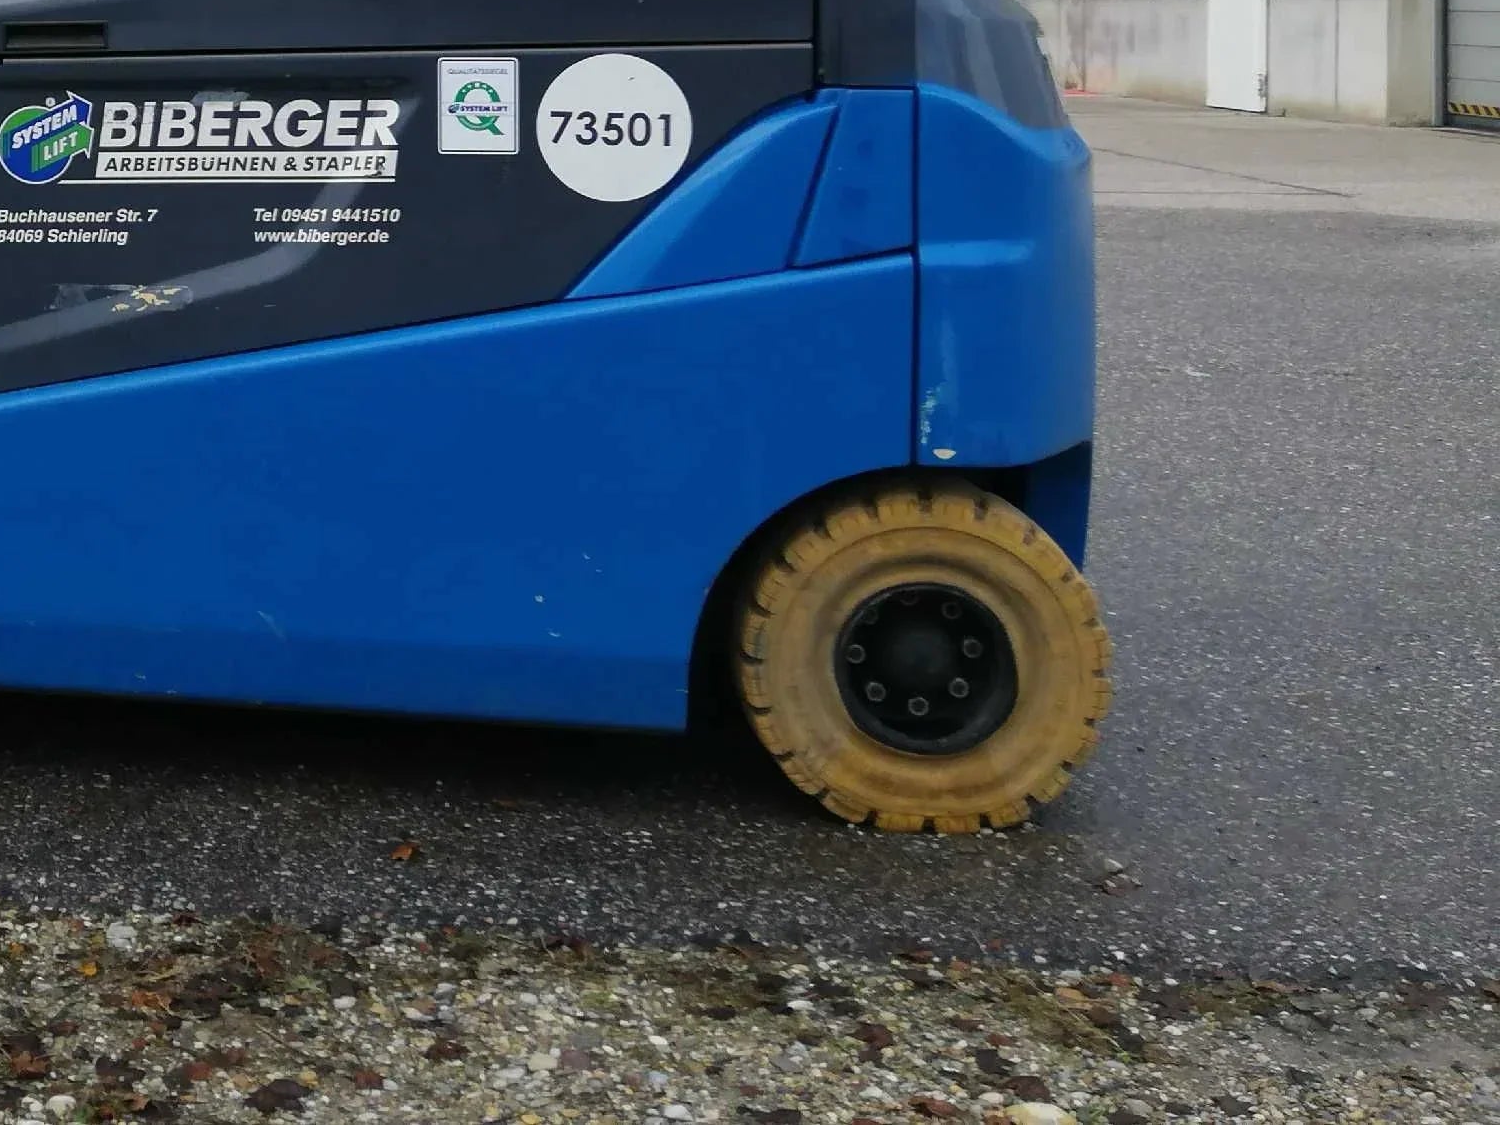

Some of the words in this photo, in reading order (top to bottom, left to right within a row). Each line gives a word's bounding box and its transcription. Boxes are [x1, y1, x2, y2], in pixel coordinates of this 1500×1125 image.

[11, 104, 78, 149] SYSTEM
[99, 99, 400, 147] BIBERGER
[550, 110, 672, 147] 73501
[43, 131, 79, 161] LIFT
[104, 155, 277, 172] ARBEITSBÜHNEN
[283, 156, 299, 172] &
[302, 155, 387, 172] STAPLER
[115, 208, 143, 222] Str.
[146, 208, 159, 222] 7
[253, 208, 279, 222] Tel
[281, 208, 327, 222] 09451
[331, 208, 401, 222] 9441510
[47, 229, 129, 245] Schierling
[254, 229, 390, 246] www.biberger.de
